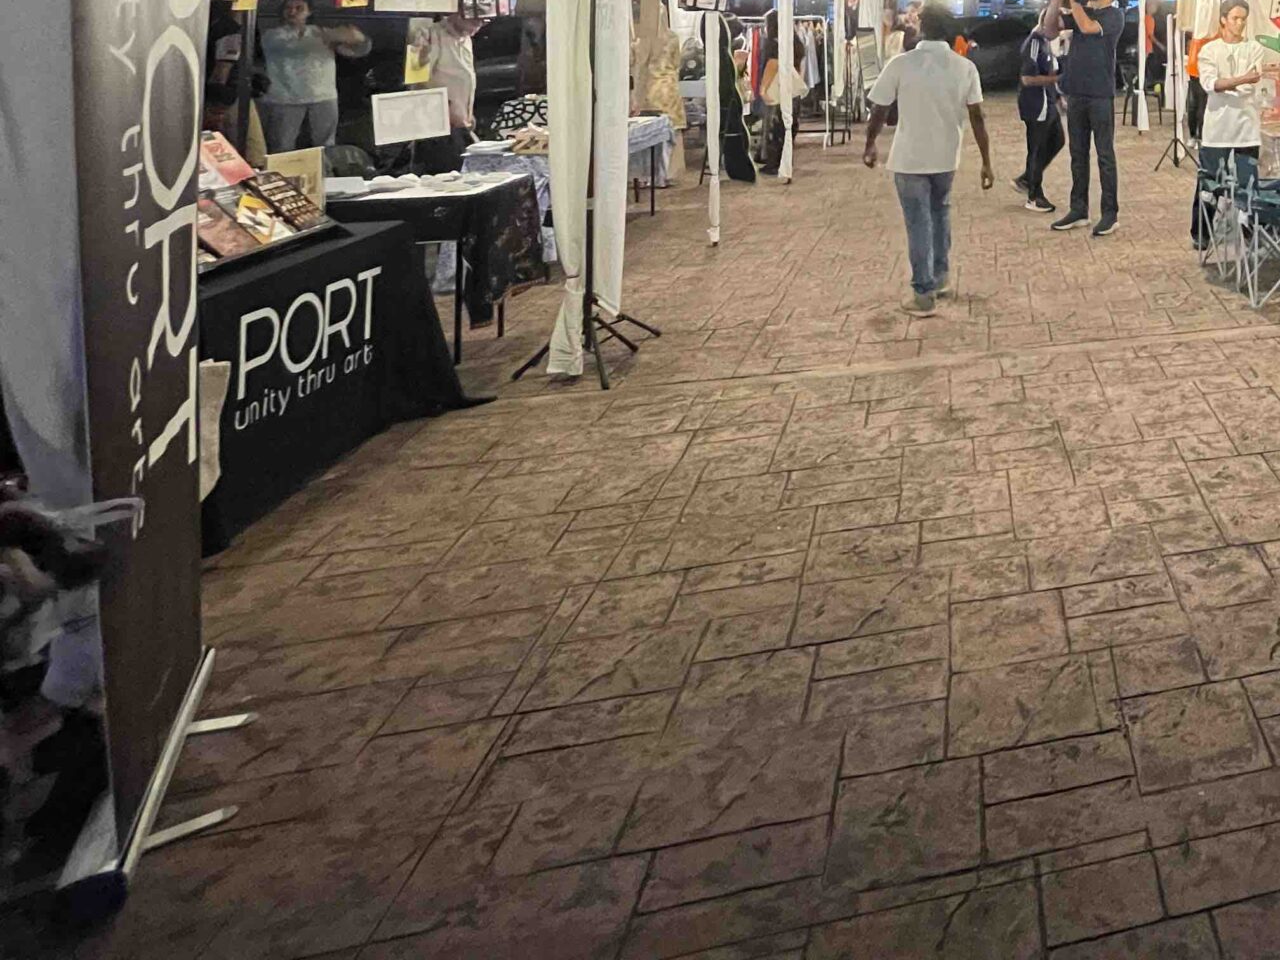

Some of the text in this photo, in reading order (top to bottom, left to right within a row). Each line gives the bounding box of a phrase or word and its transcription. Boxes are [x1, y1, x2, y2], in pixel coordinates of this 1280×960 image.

[234, 344, 374, 430] unity thru art
[237, 266, 382, 400] PORT
